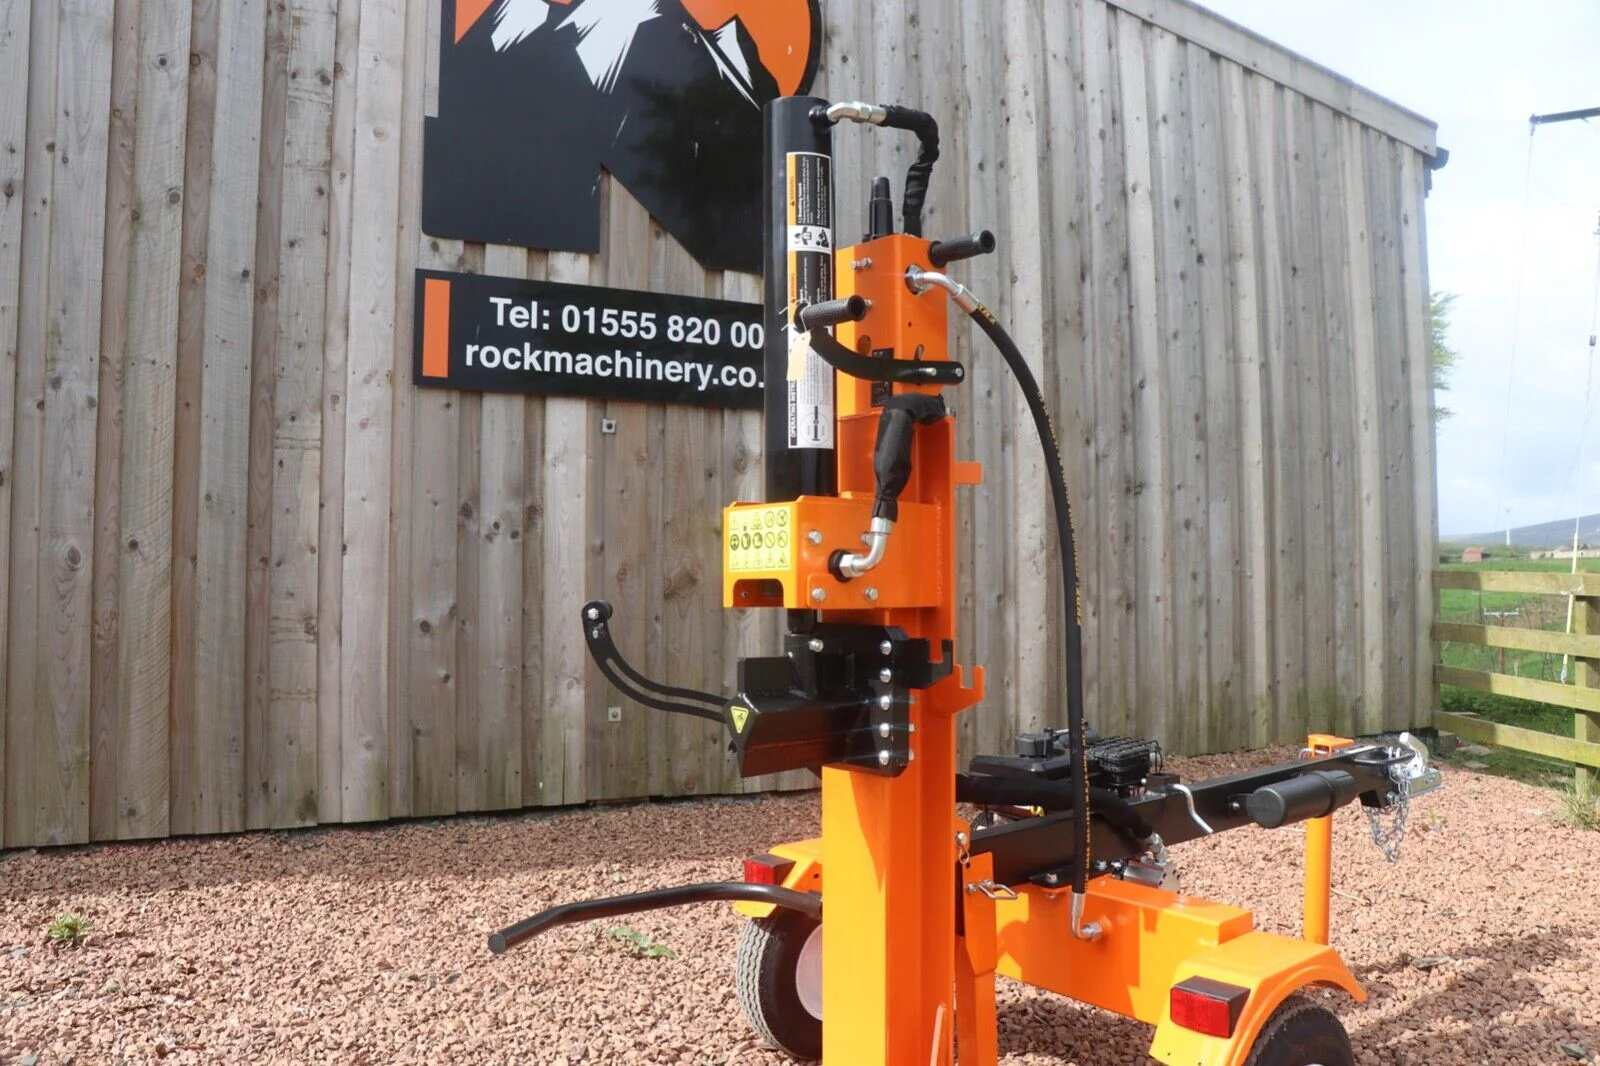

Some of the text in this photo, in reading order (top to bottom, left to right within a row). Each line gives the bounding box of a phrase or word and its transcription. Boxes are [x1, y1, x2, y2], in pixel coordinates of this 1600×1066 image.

[489, 296, 765, 350] Tel: 01555 820 00
[465, 342, 765, 391] rockmachinery.co.
